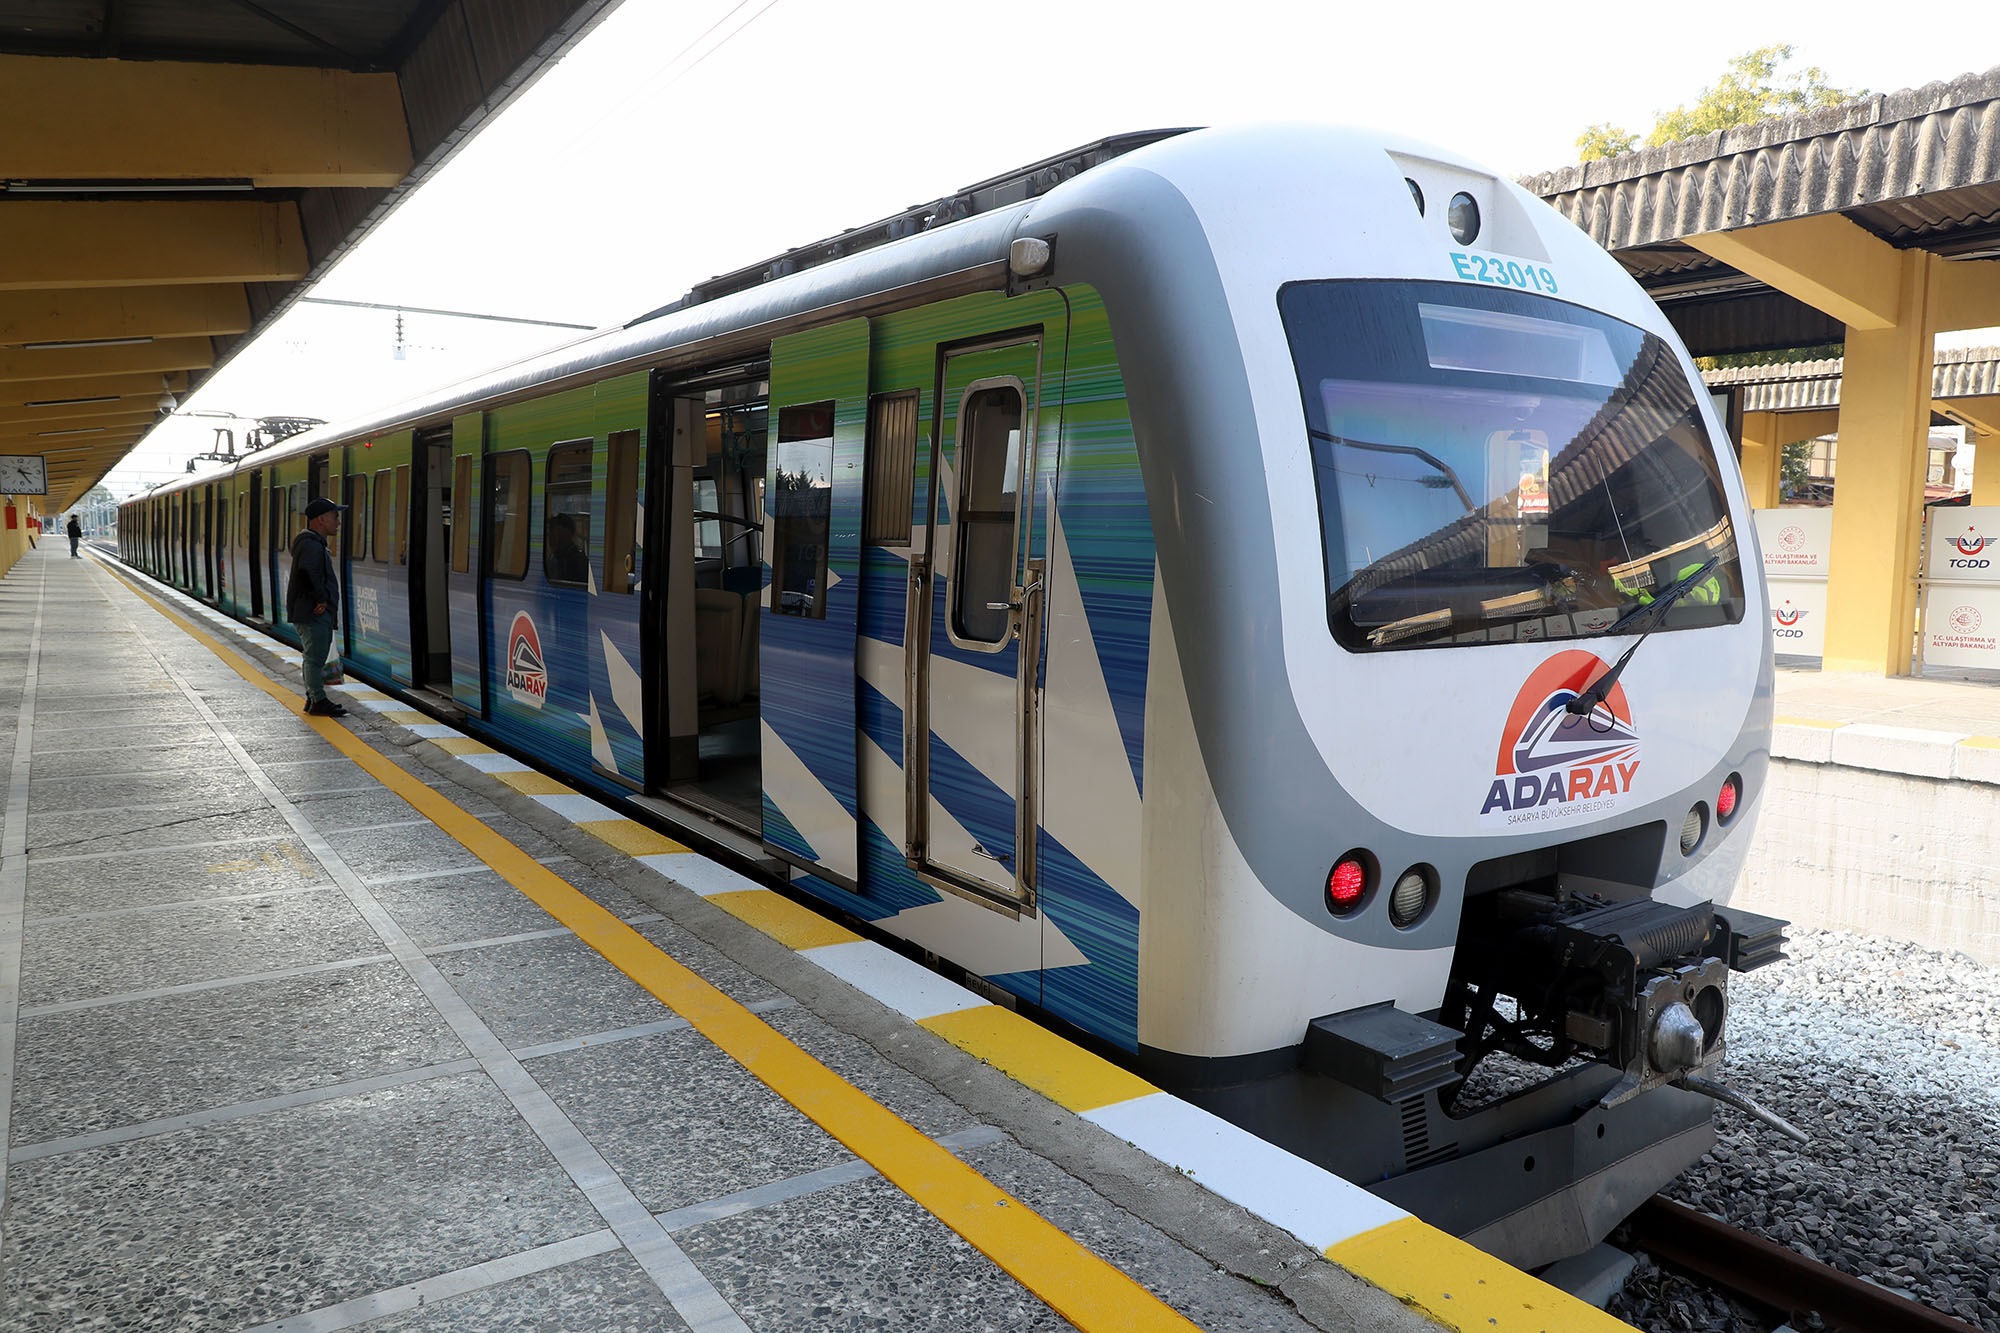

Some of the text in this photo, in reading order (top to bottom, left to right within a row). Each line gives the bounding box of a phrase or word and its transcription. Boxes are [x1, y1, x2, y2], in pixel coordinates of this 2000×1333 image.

[1449, 251, 1558, 294] E23019
[1948, 558, 1991, 569] TCDD
[507, 670, 546, 698] ADARAY
[1480, 760, 1641, 815] ADARAY
[1507, 811, 1540, 825] SAKARYA
